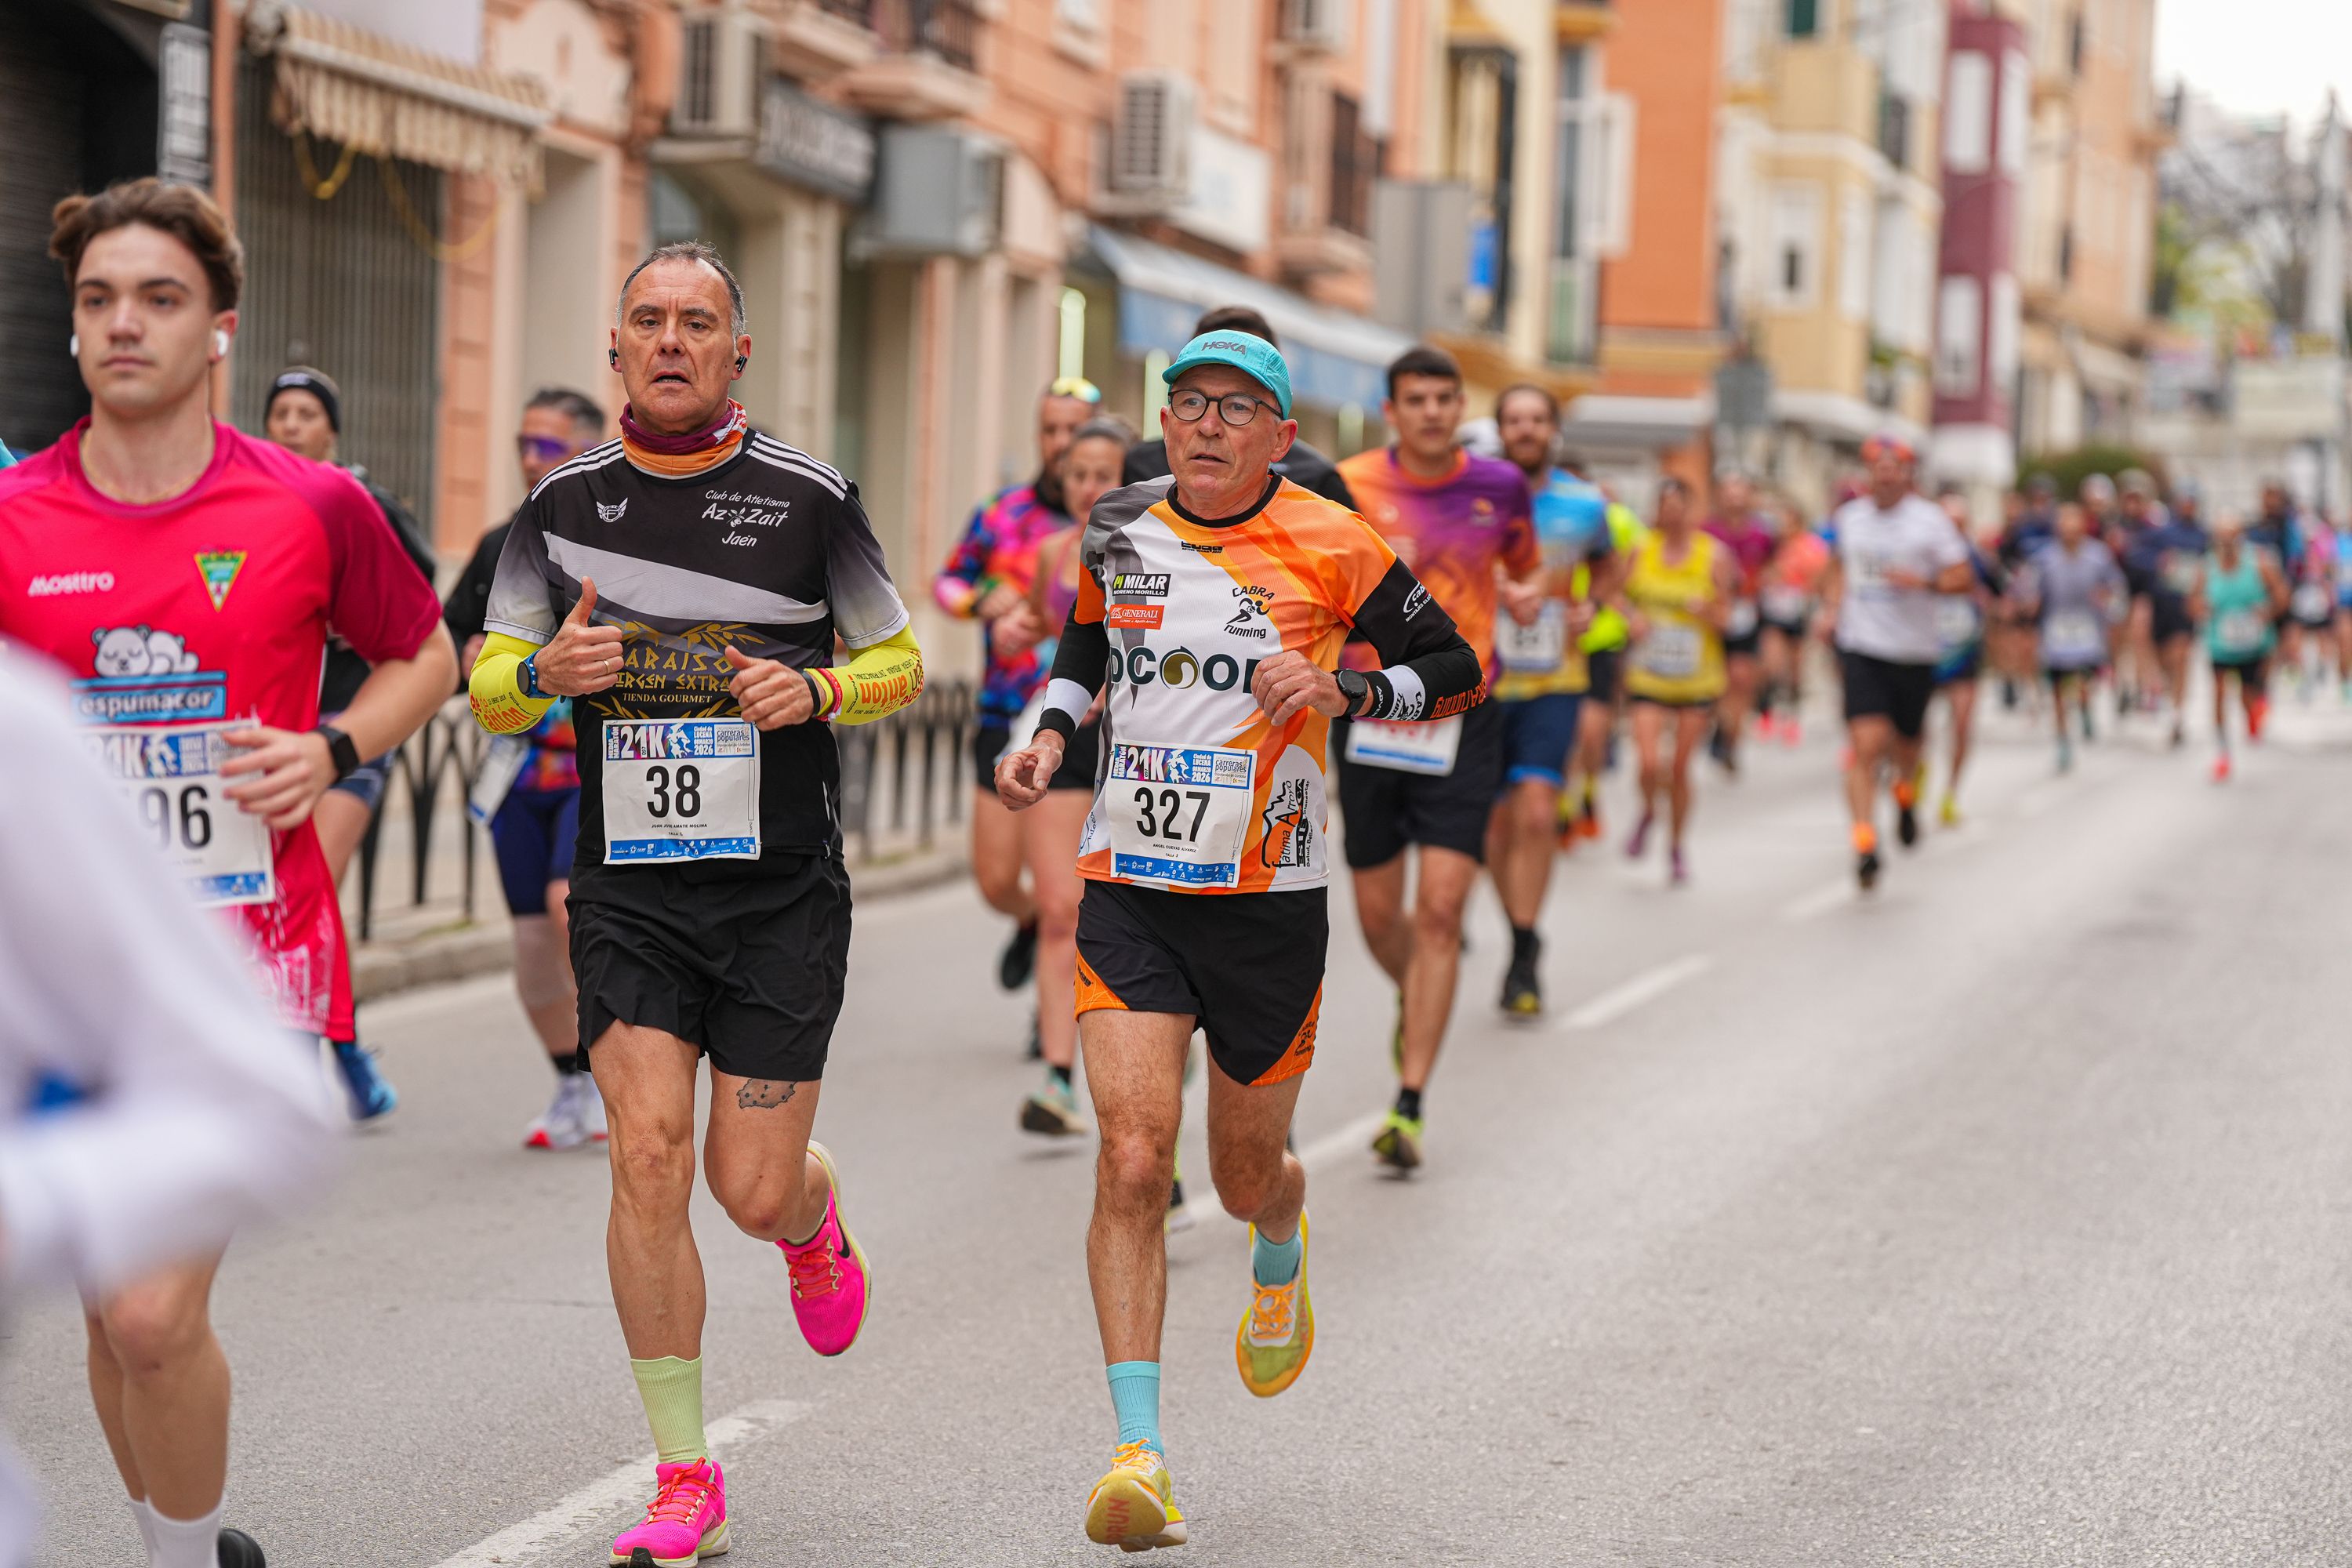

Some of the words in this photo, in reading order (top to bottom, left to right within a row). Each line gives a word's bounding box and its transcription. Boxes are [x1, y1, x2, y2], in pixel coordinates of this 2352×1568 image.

[1201, 341, 1247, 355] HOKA
[705, 489, 728, 500] Club
[728, 492, 742, 502] de
[743, 494, 790, 508] Atletismo
[702, 503, 724, 520] Az
[743, 508, 789, 528] Zait
[721, 530, 757, 547] Jaén
[28, 572, 114, 596] Mosttro
[1123, 575, 1167, 590] MILAR
[1232, 586, 1275, 601] CABRA
[1122, 609, 1159, 618] GENERALI
[1405, 603, 1424, 622] MONTAJES
[1224, 624, 1266, 639] running
[625, 646, 735, 674] ARAISO
[615, 672, 666, 690] IRGEN
[676, 673, 731, 692] EXTRA
[859, 674, 908, 710] antón
[79, 689, 213, 721] espumacor
[622, 693, 657, 702] TIENDA
[659, 695, 712, 703] GOURMET
[620, 725, 666, 759] 21K
[694, 745, 713, 755] 2026
[1127, 746, 1166, 781] 21K
[1192, 772, 1210, 783] 2026
[646, 764, 701, 818] 38
[1275, 780, 1298, 827] Arroyo
[137, 784, 212, 851] 96
[1134, 787, 1210, 842] 327
